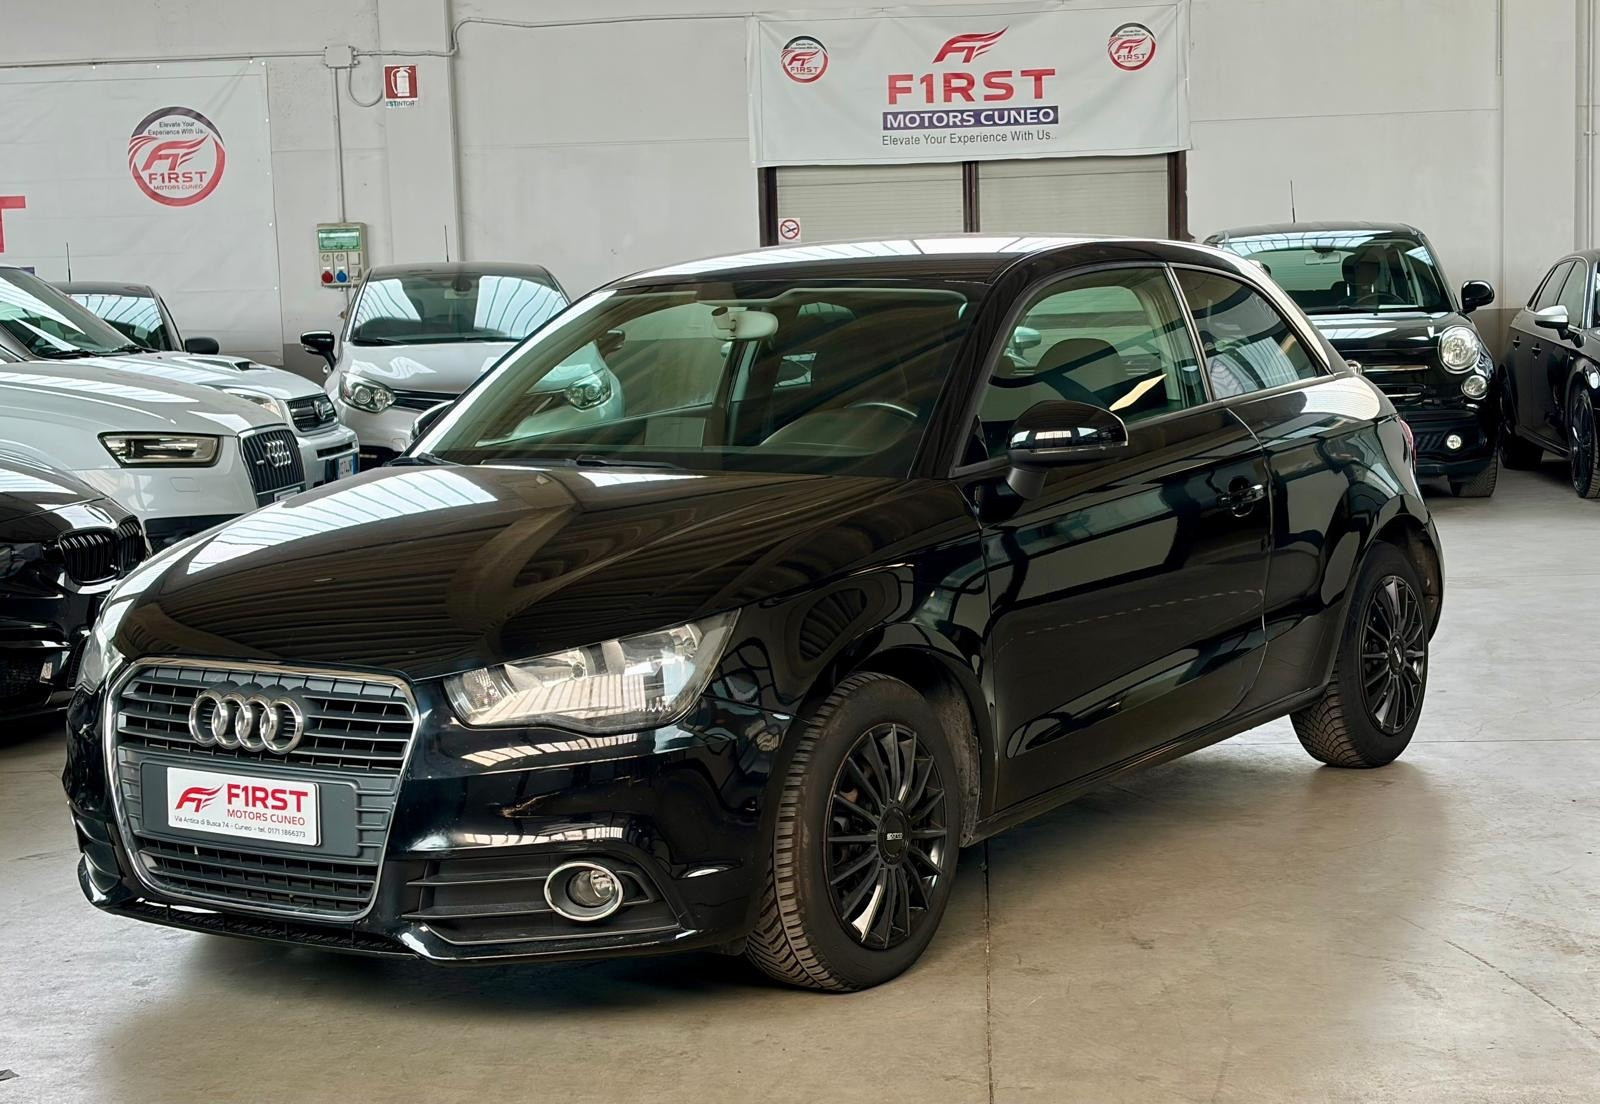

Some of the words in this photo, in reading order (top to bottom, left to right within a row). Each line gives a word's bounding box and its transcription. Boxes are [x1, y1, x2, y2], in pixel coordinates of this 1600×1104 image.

[888, 69, 1055, 105] F1RST
[886, 112, 975, 128] MOTORS
[979, 108, 1054, 125] CUNEO
[148, 128, 180, 136] Experience
[882, 135, 920, 146] Elevate
[923, 134, 946, 145] Your
[950, 132, 1007, 145] Experience
[1010, 130, 1033, 141] With
[148, 171, 207, 184] F1RST
[226, 783, 308, 813] F1RST
[206, 819, 222, 828] Busca
[234, 822, 253, 831] Cuneo
[227, 808, 268, 822] MOTORS
[270, 813, 306, 826] CUNEO
